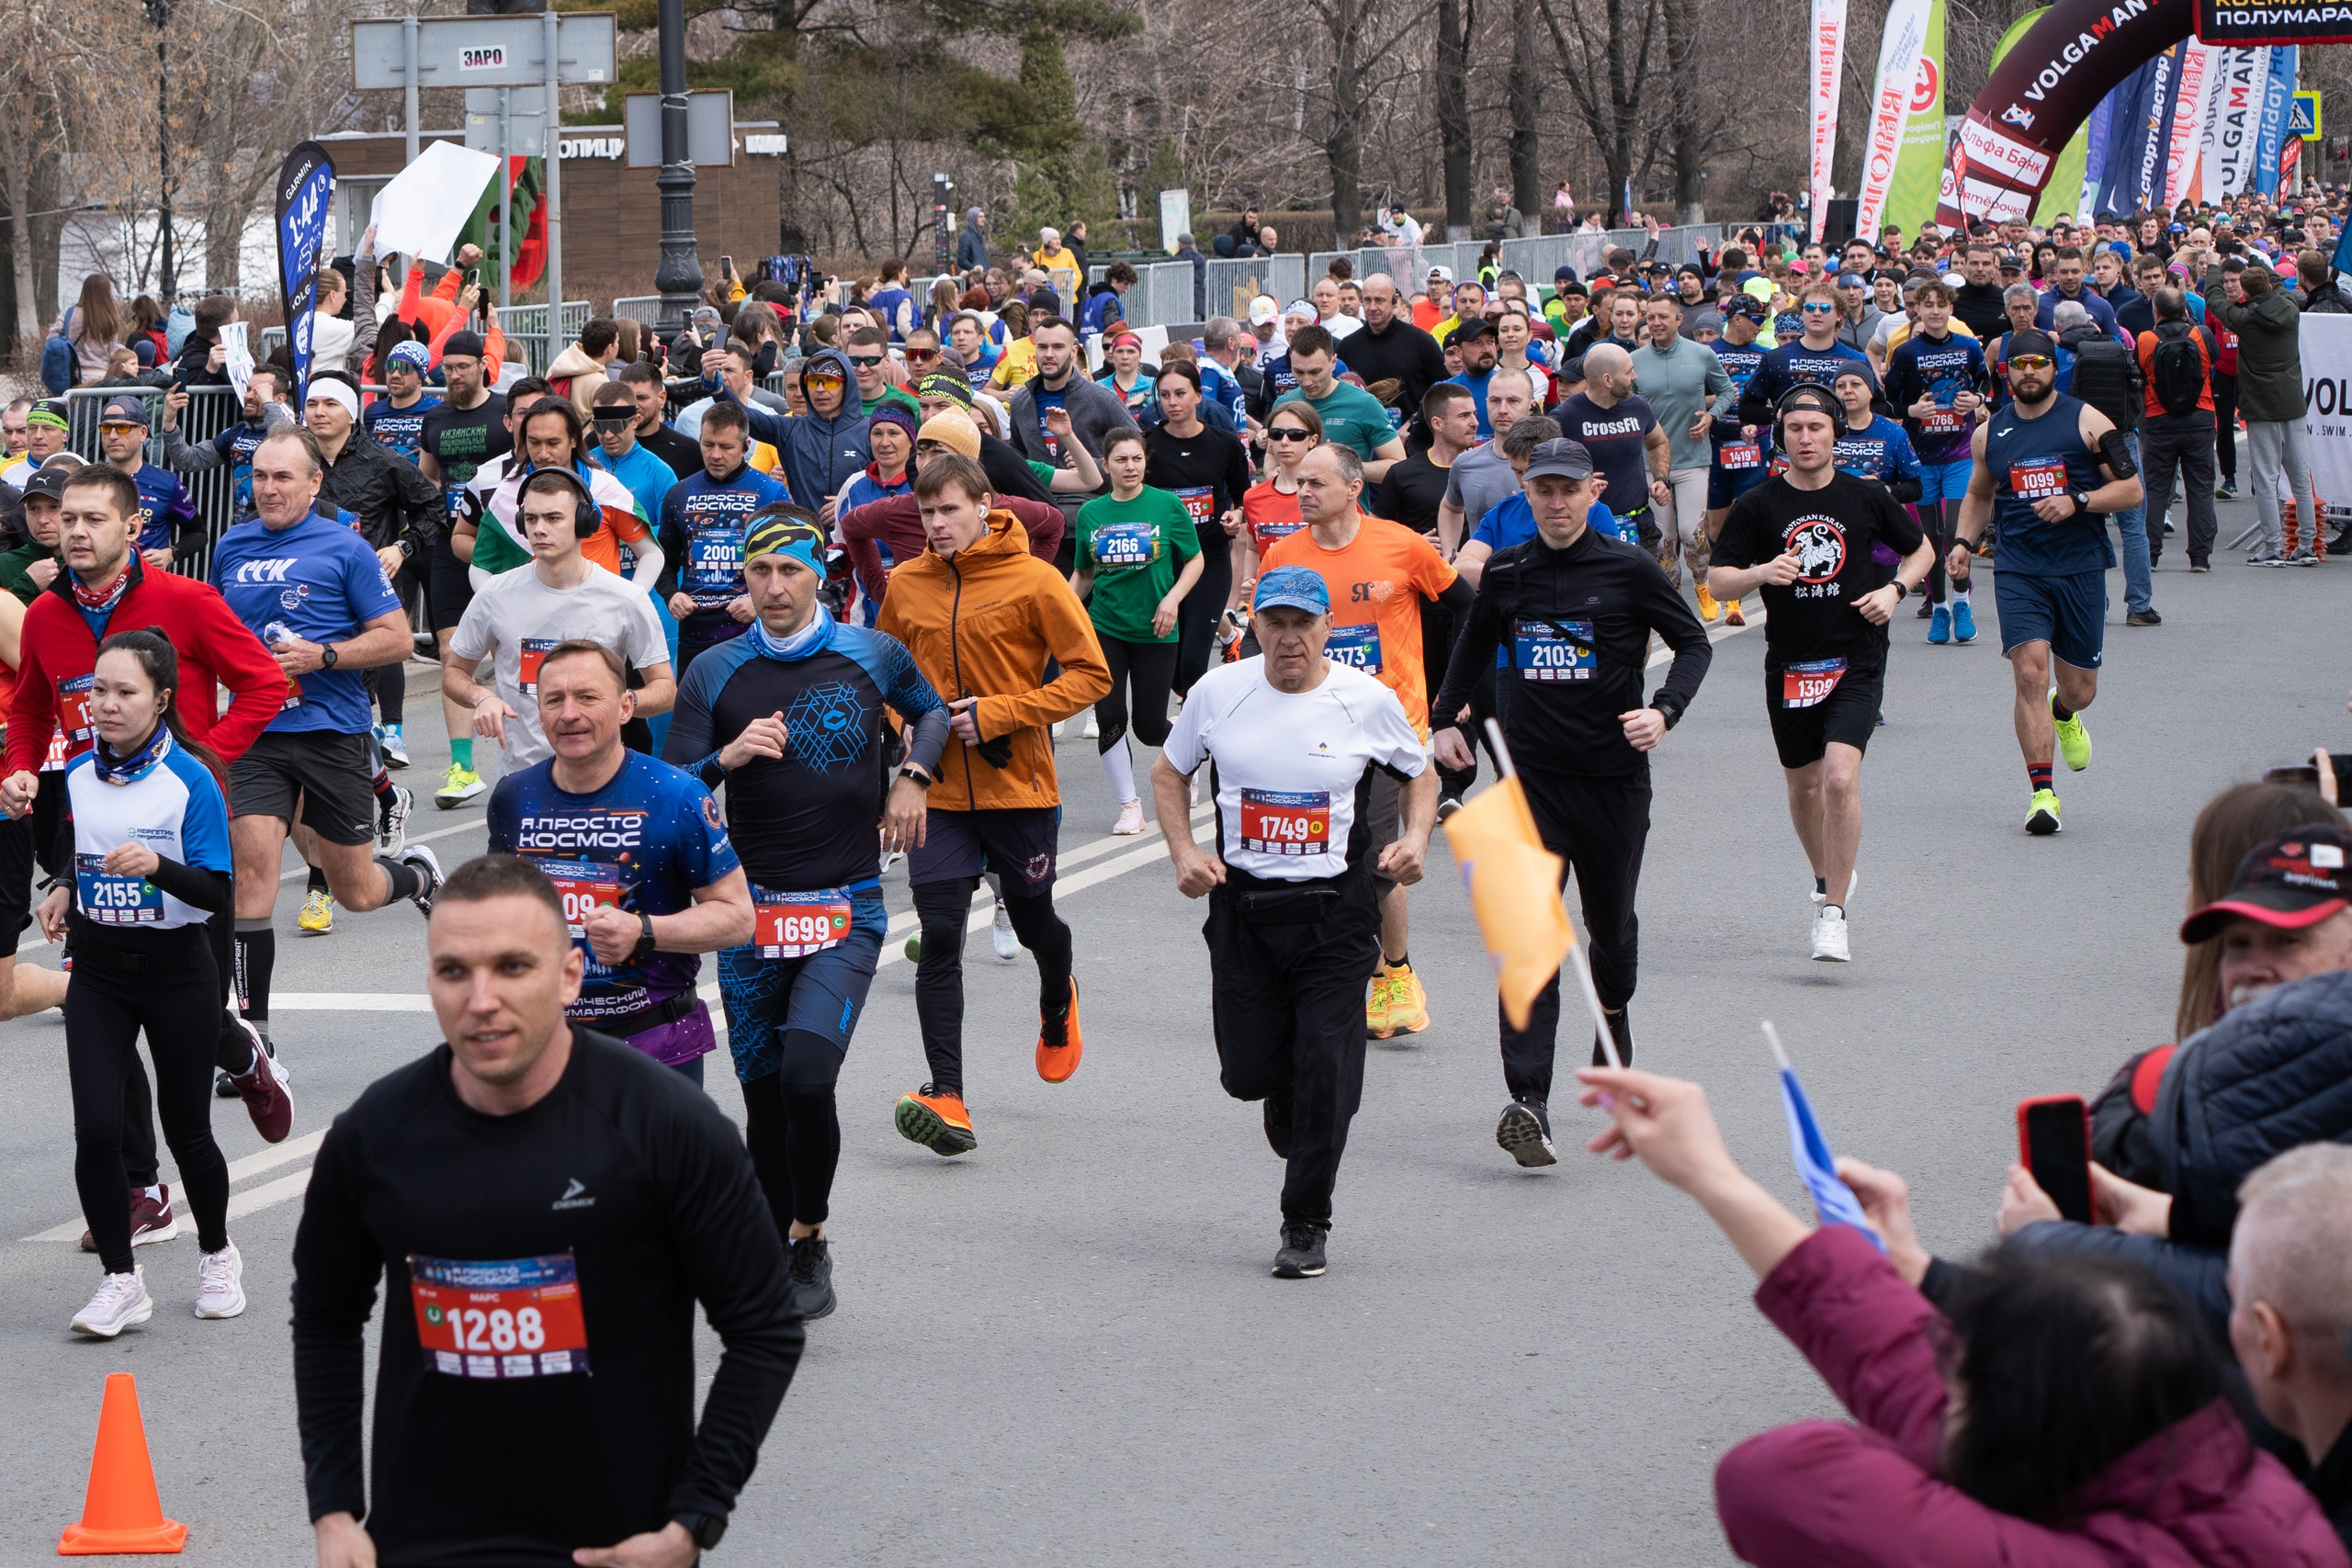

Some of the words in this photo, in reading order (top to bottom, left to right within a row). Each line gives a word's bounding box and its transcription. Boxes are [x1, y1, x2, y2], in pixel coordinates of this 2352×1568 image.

[2026, 0, 2148, 103] VOLGAMAN
[2222, 46, 2256, 186] OLGAMAN
[2260, 74, 2286, 173] Holiday
[1961, 120, 2007, 159] Альфа
[2007, 150, 2043, 176] Банк
[285, 159, 311, 201] GARMIN
[1957, 186, 2025, 217] ятёрочка
[1917, 357, 1967, 368] КОСМОС
[1582, 417, 1641, 437] CrossFit
[1931, 414, 1953, 425] 1766
[440, 424, 487, 439] КАЗАНСКИЙ
[2323, 424, 2346, 436] SWIM
[1730, 451, 1751, 462] 1419
[1833, 447, 1883, 456] ОСМОС
[2022, 472, 2055, 490] 1099
[685, 502, 755, 512] КОСМОС
[1187, 502, 1201, 516] 13
[1782, 513, 1818, 539] SHOTOKAN
[1819, 514, 1847, 534] KARATE
[703, 546, 736, 561] 2001
[1107, 537, 1138, 554] 2166
[1351, 582, 1375, 603] Я
[1324, 645, 1367, 665] 2373
[1532, 645, 1577, 666] 2103
[1798, 679, 1834, 697] 1309
[1260, 816, 1308, 840] 1749
[518, 831, 641, 848] КОСМОС
[553, 880, 575, 888] НДРЕЙ
[93, 882, 141, 907] 2155
[562, 893, 595, 921] 09
[774, 916, 830, 942] 1699
[234, 939, 244, 998] COMPRESSPRINT
[563, 997, 651, 1017] УМАРАФОН
[570, 987, 647, 1007] ИЧЕСКИЙ
[839, 997, 854, 1033] SPORT
[552, 1197, 595, 1211] DEMIX
[469, 1292, 500, 1303] МАРС
[447, 1306, 546, 1351] 1288
